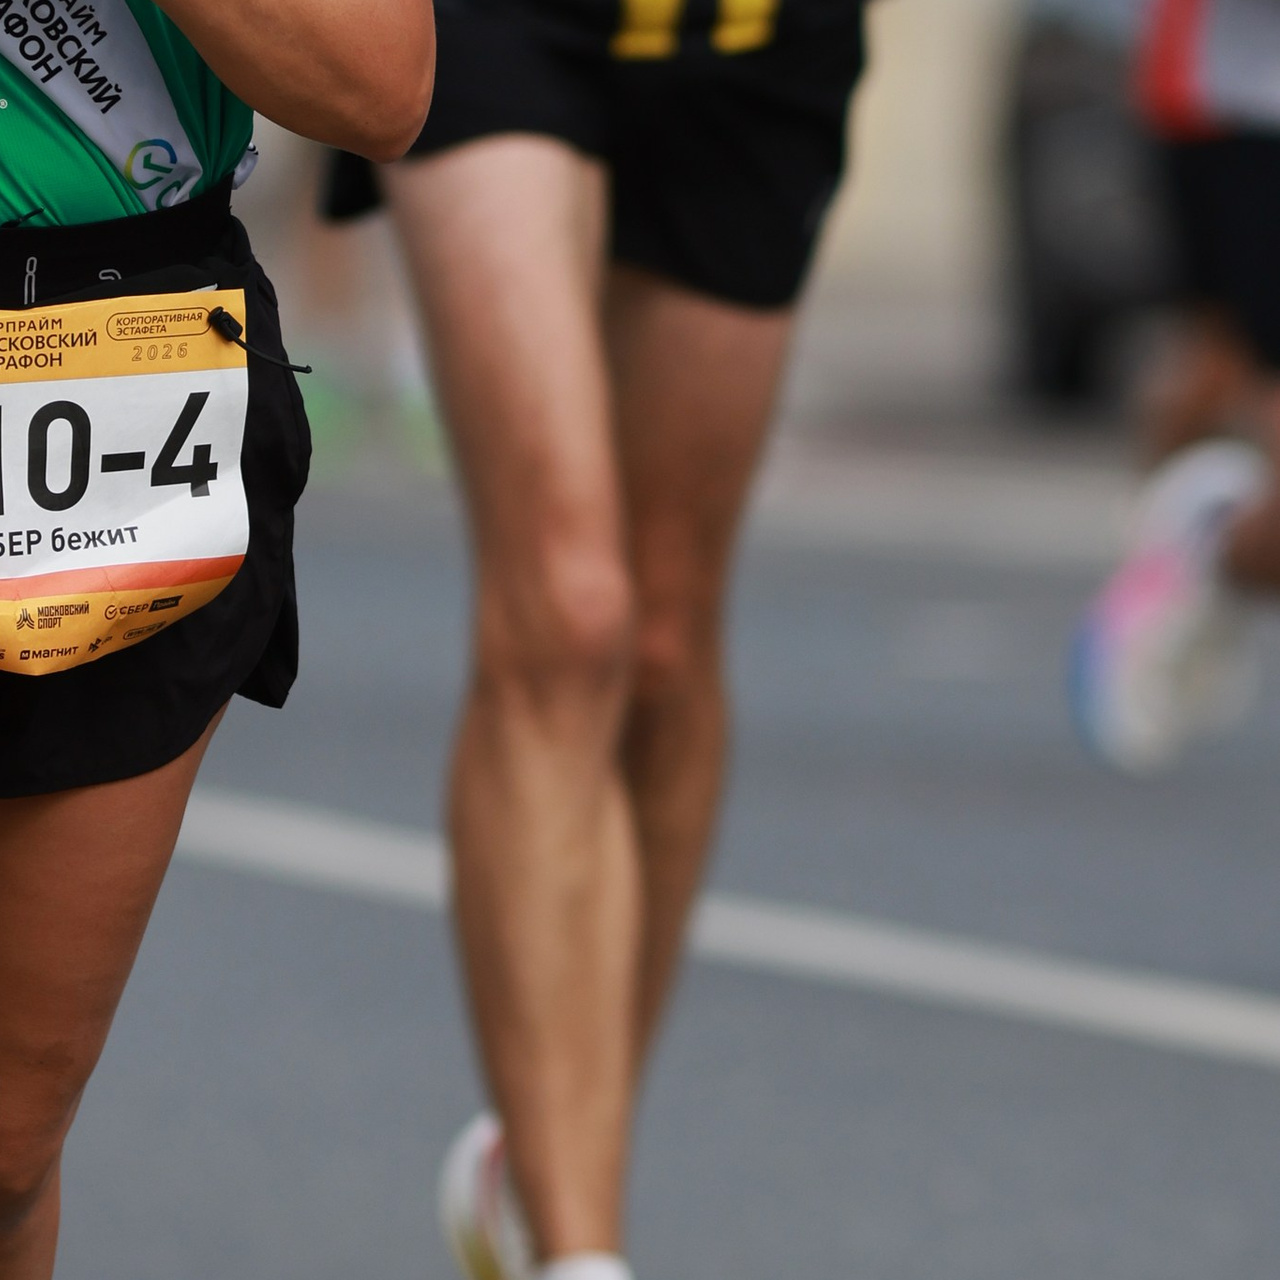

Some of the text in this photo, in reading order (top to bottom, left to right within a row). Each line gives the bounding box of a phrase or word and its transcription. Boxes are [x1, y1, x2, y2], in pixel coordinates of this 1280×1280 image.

[116, 312, 204, 327] КОРПОРАТИВНАЯ
[115, 325, 167, 337] ЭСТАФЕТА
[131, 342, 189, 362] 2026
[51, 526, 139, 553] бежит
[37, 600, 90, 618] МОСКОВСКИЙ
[119, 603, 149, 616] СБЕР
[37, 616, 62, 630] СПОРТ
